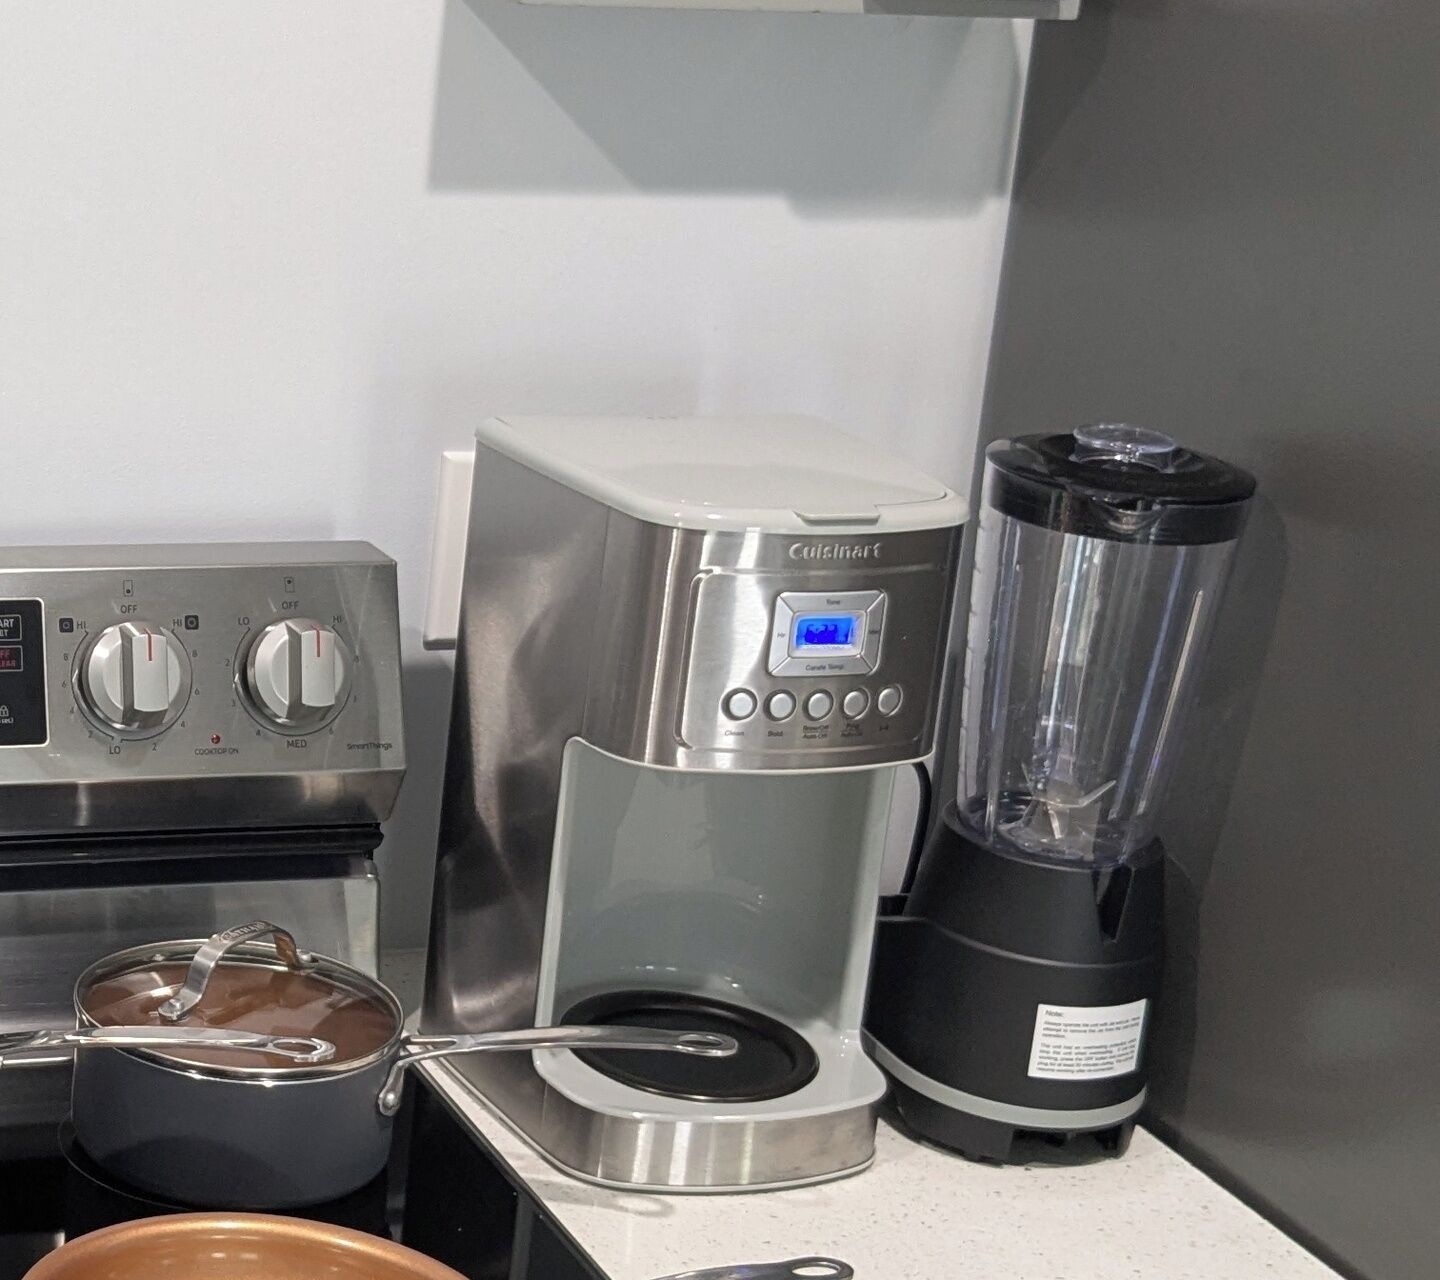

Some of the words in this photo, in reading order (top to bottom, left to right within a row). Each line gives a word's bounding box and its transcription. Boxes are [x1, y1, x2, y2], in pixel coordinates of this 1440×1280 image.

[788, 542, 882, 561] Cuisinart
[120, 604, 138, 614] OFF
[282, 601, 300, 610] OFF
[76, 621, 86, 630] HI
[172, 618, 182, 627] HI
[238, 617, 250, 625] LO
[286, 740, 308, 749] MED
[346, 742, 393, 751] SmartThings
[109, 745, 121, 755] LO
